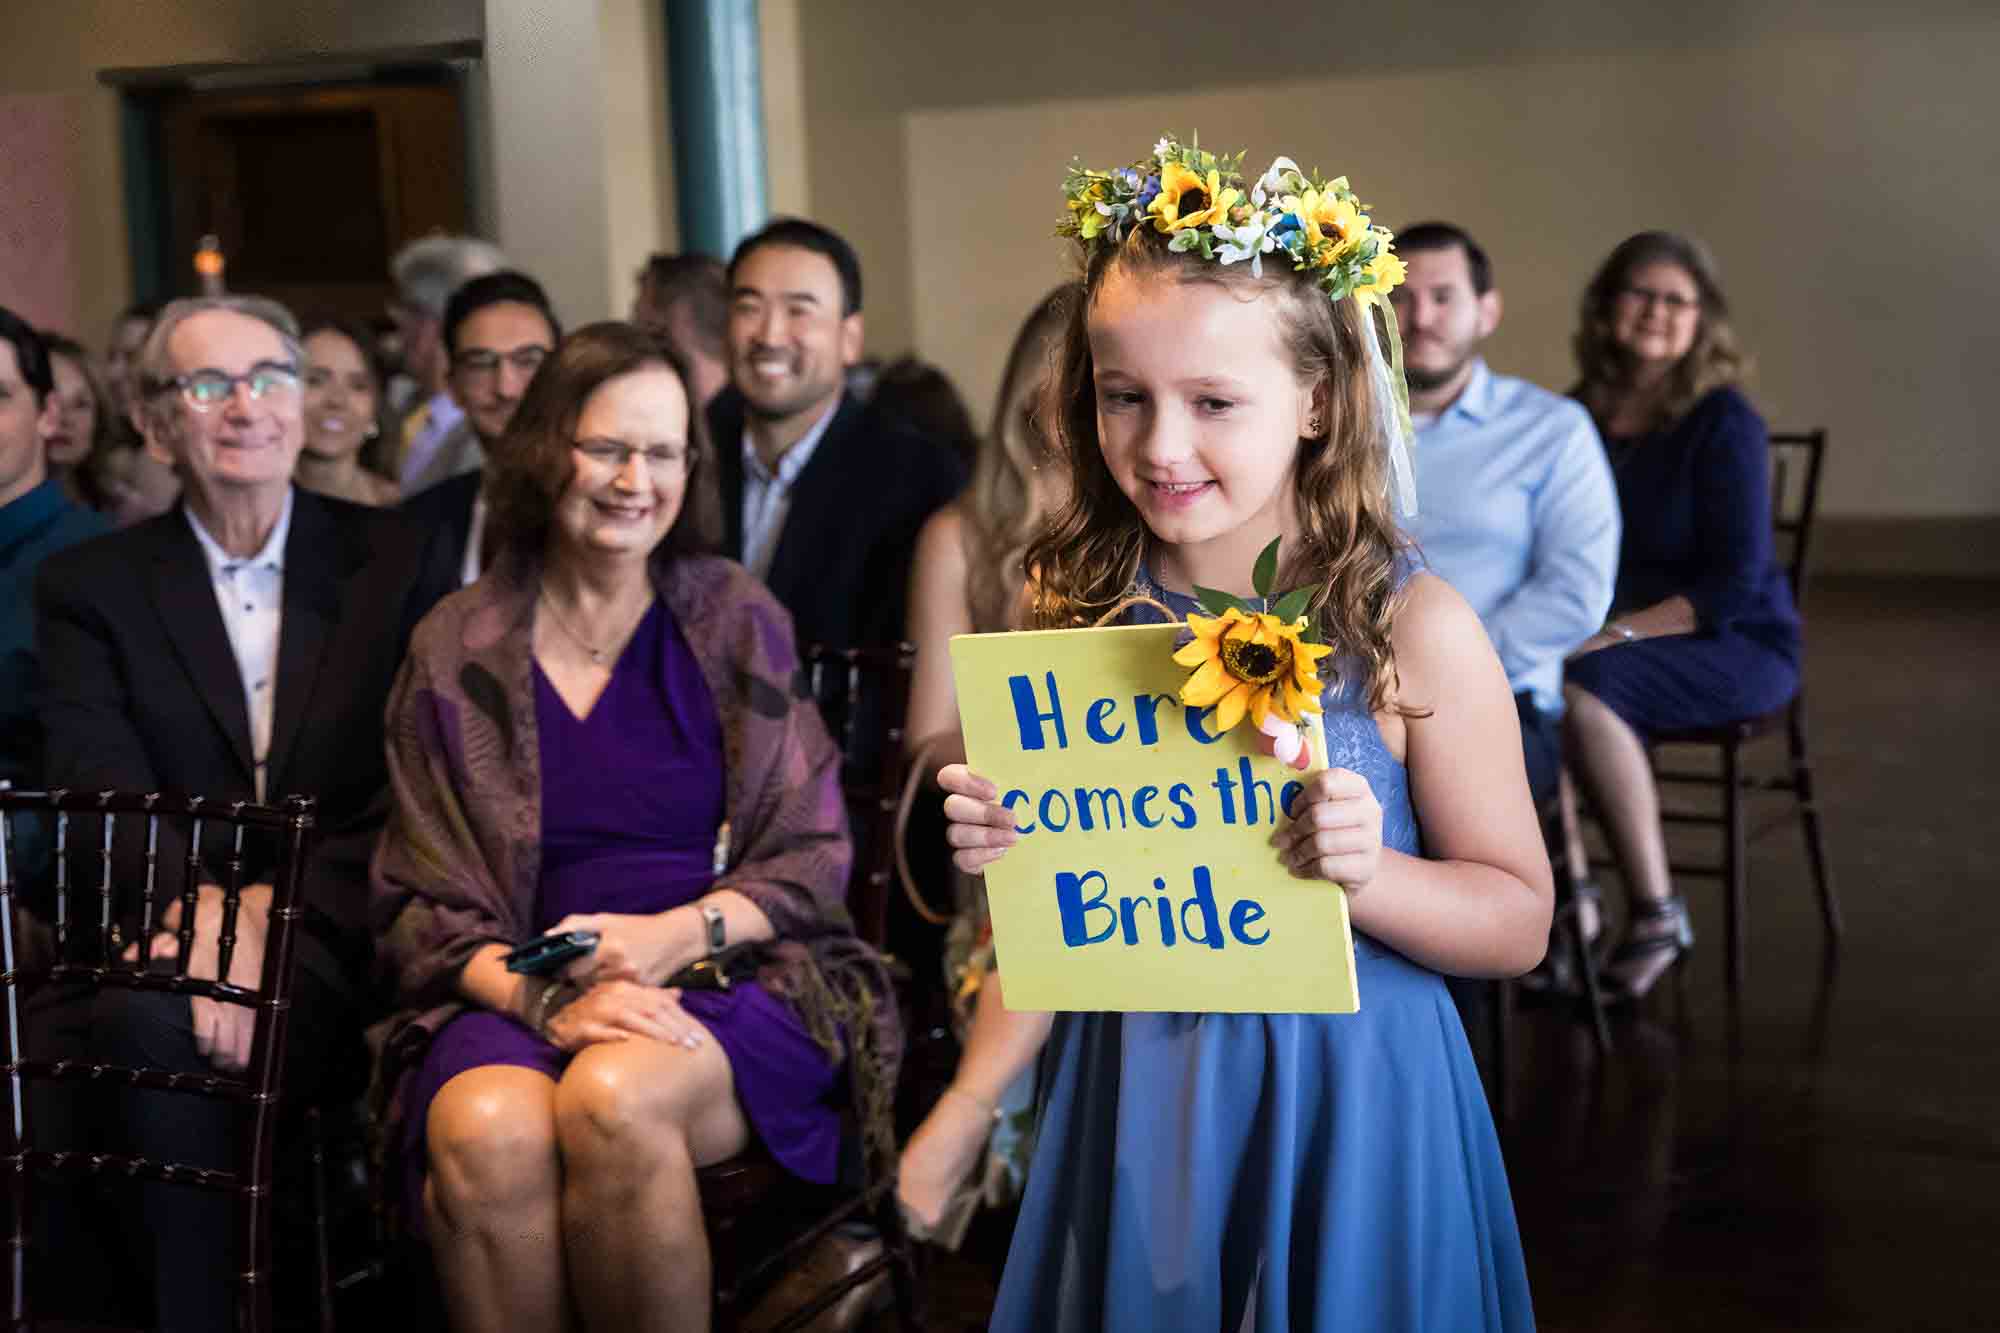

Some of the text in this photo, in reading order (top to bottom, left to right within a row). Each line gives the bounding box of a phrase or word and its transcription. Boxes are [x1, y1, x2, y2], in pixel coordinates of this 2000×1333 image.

[1008, 671, 1225, 750] Here
[1001, 784, 1197, 834] comes
[1055, 865, 1271, 950] Bride
